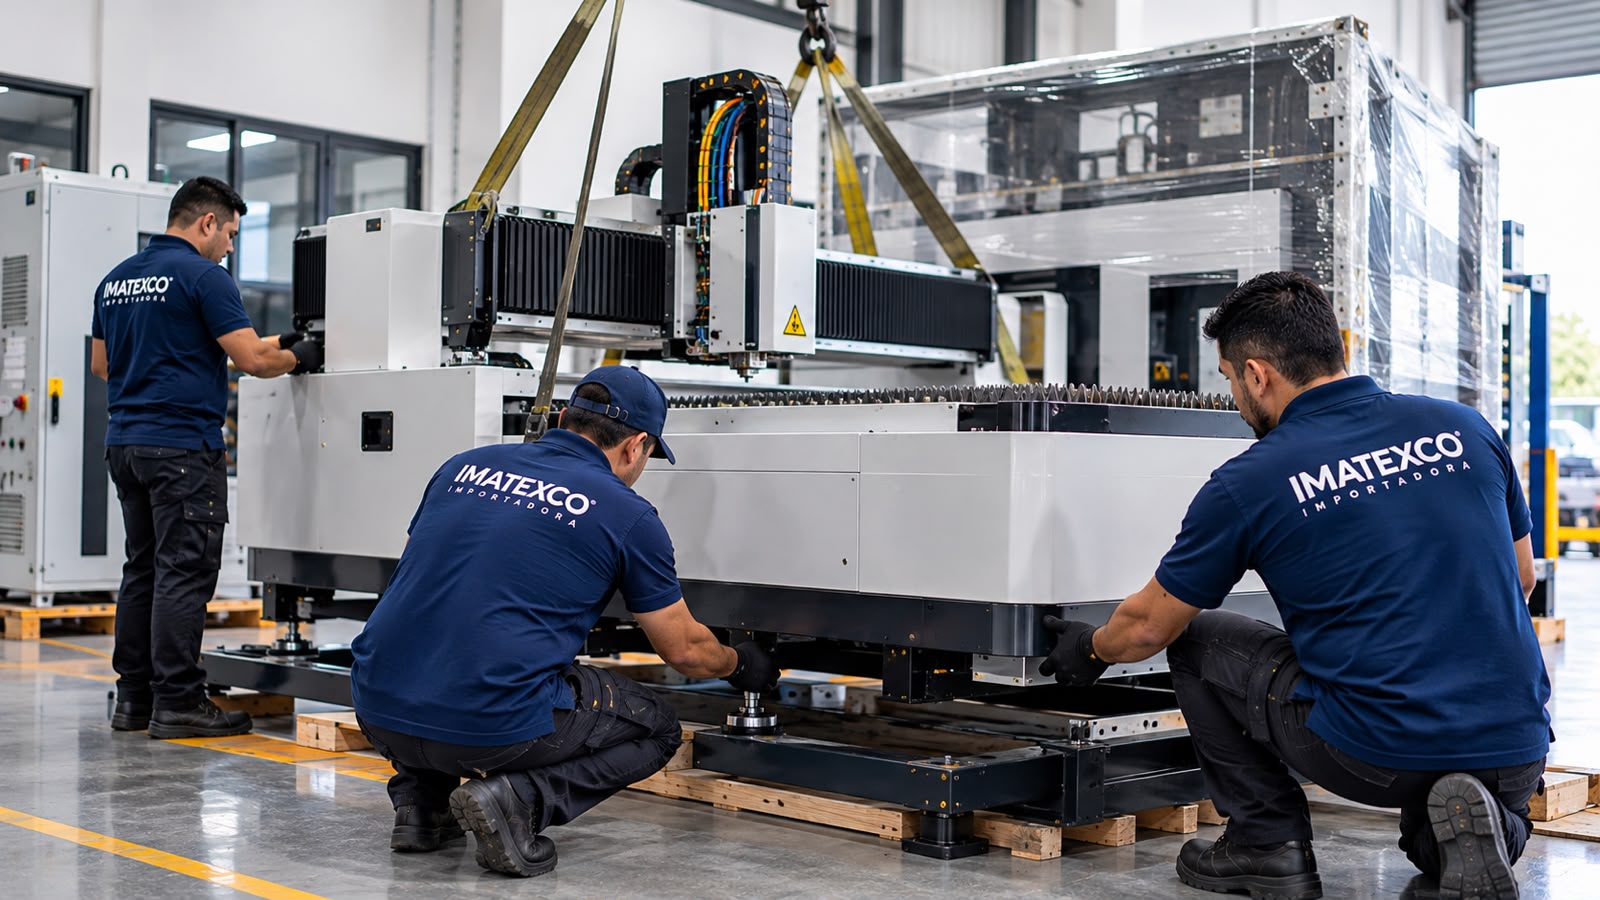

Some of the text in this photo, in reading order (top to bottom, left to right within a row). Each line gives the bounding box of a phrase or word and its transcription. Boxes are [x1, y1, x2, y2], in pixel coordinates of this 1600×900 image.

[103, 276, 169, 299] IMATEXCO
[453, 464, 590, 516] IMATEXCO
[1288, 432, 1464, 504] IMATEXCO
[1301, 460, 1471, 518] IMPORTADORA
[447, 485, 577, 529] IMPORTADORA
